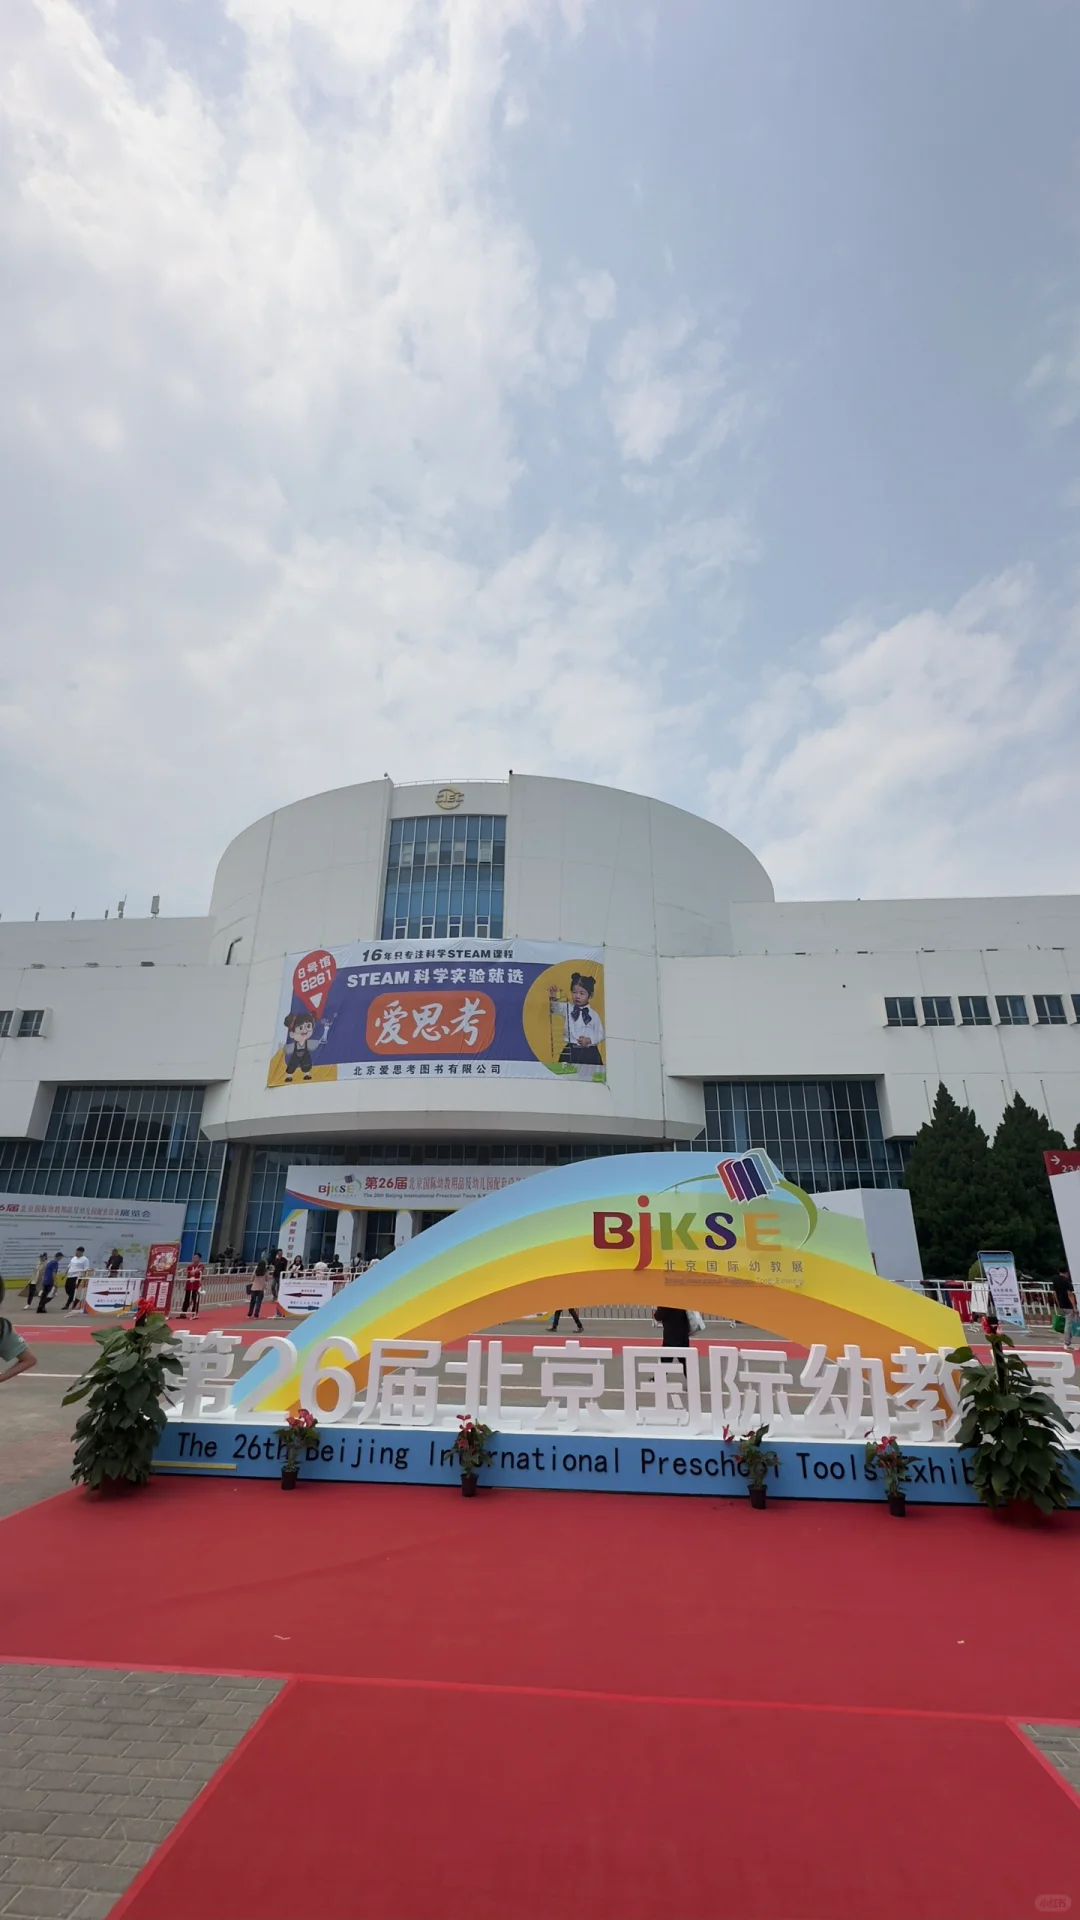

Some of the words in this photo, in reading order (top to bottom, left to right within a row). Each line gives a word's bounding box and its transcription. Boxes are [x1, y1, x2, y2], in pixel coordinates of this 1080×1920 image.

[298, 955, 331, 979] 8号馆
[362, 948, 514, 962] 16年只专注科学STEAM课程
[301, 969, 332, 993] 8261
[347, 970, 410, 988] STEAM
[413, 968, 524, 985] 科学实验就选
[374, 997, 487, 1046] 爱思考
[353, 1064, 501, 1076] 北京爱思考图书有限公司
[593, 1195, 783, 1271] BjKSE
[664, 1259, 804, 1273] 北京国际幼教展
[178, 1432, 218, 1458] The
[232, 1433, 289, 1460] 26th
[305, 1438, 410, 1469] Beijing
[429, 1440, 619, 1473] Inrnational
[796, 1452, 878, 1481] Tools
